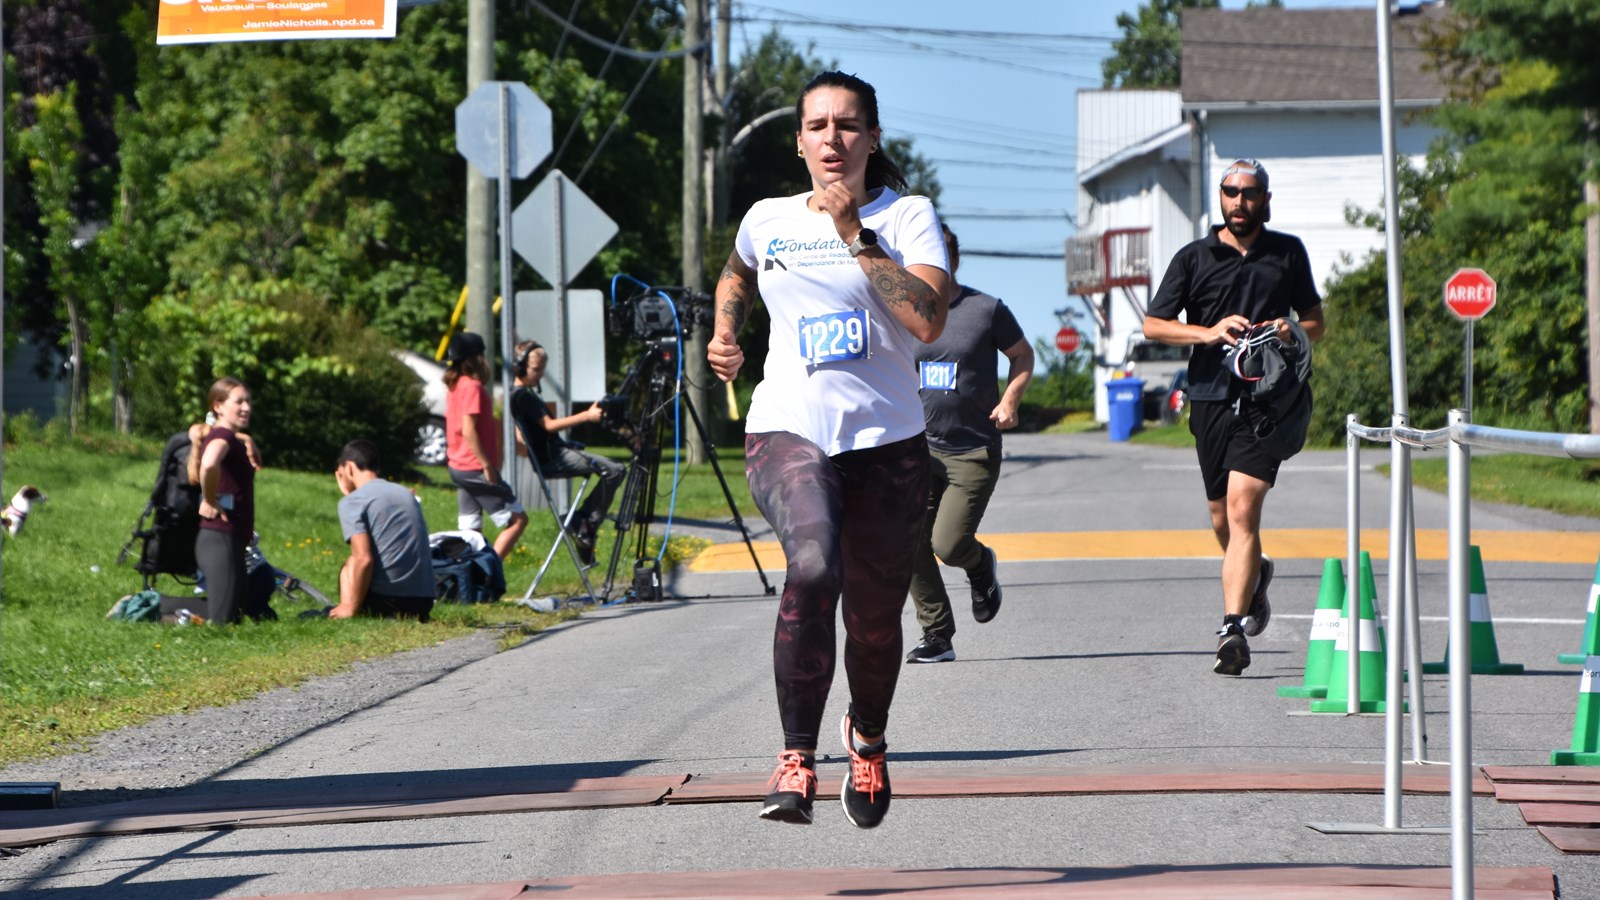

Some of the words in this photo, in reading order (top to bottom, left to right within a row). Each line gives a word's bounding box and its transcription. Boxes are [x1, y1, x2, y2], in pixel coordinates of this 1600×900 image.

[242, 18, 375, 29] JamieNicholls.npd.ca
[783, 238, 849, 252] Fondatio
[1449, 282, 1493, 303] ARRÊT
[801, 317, 864, 359] 1229
[925, 366, 949, 386] 1211
